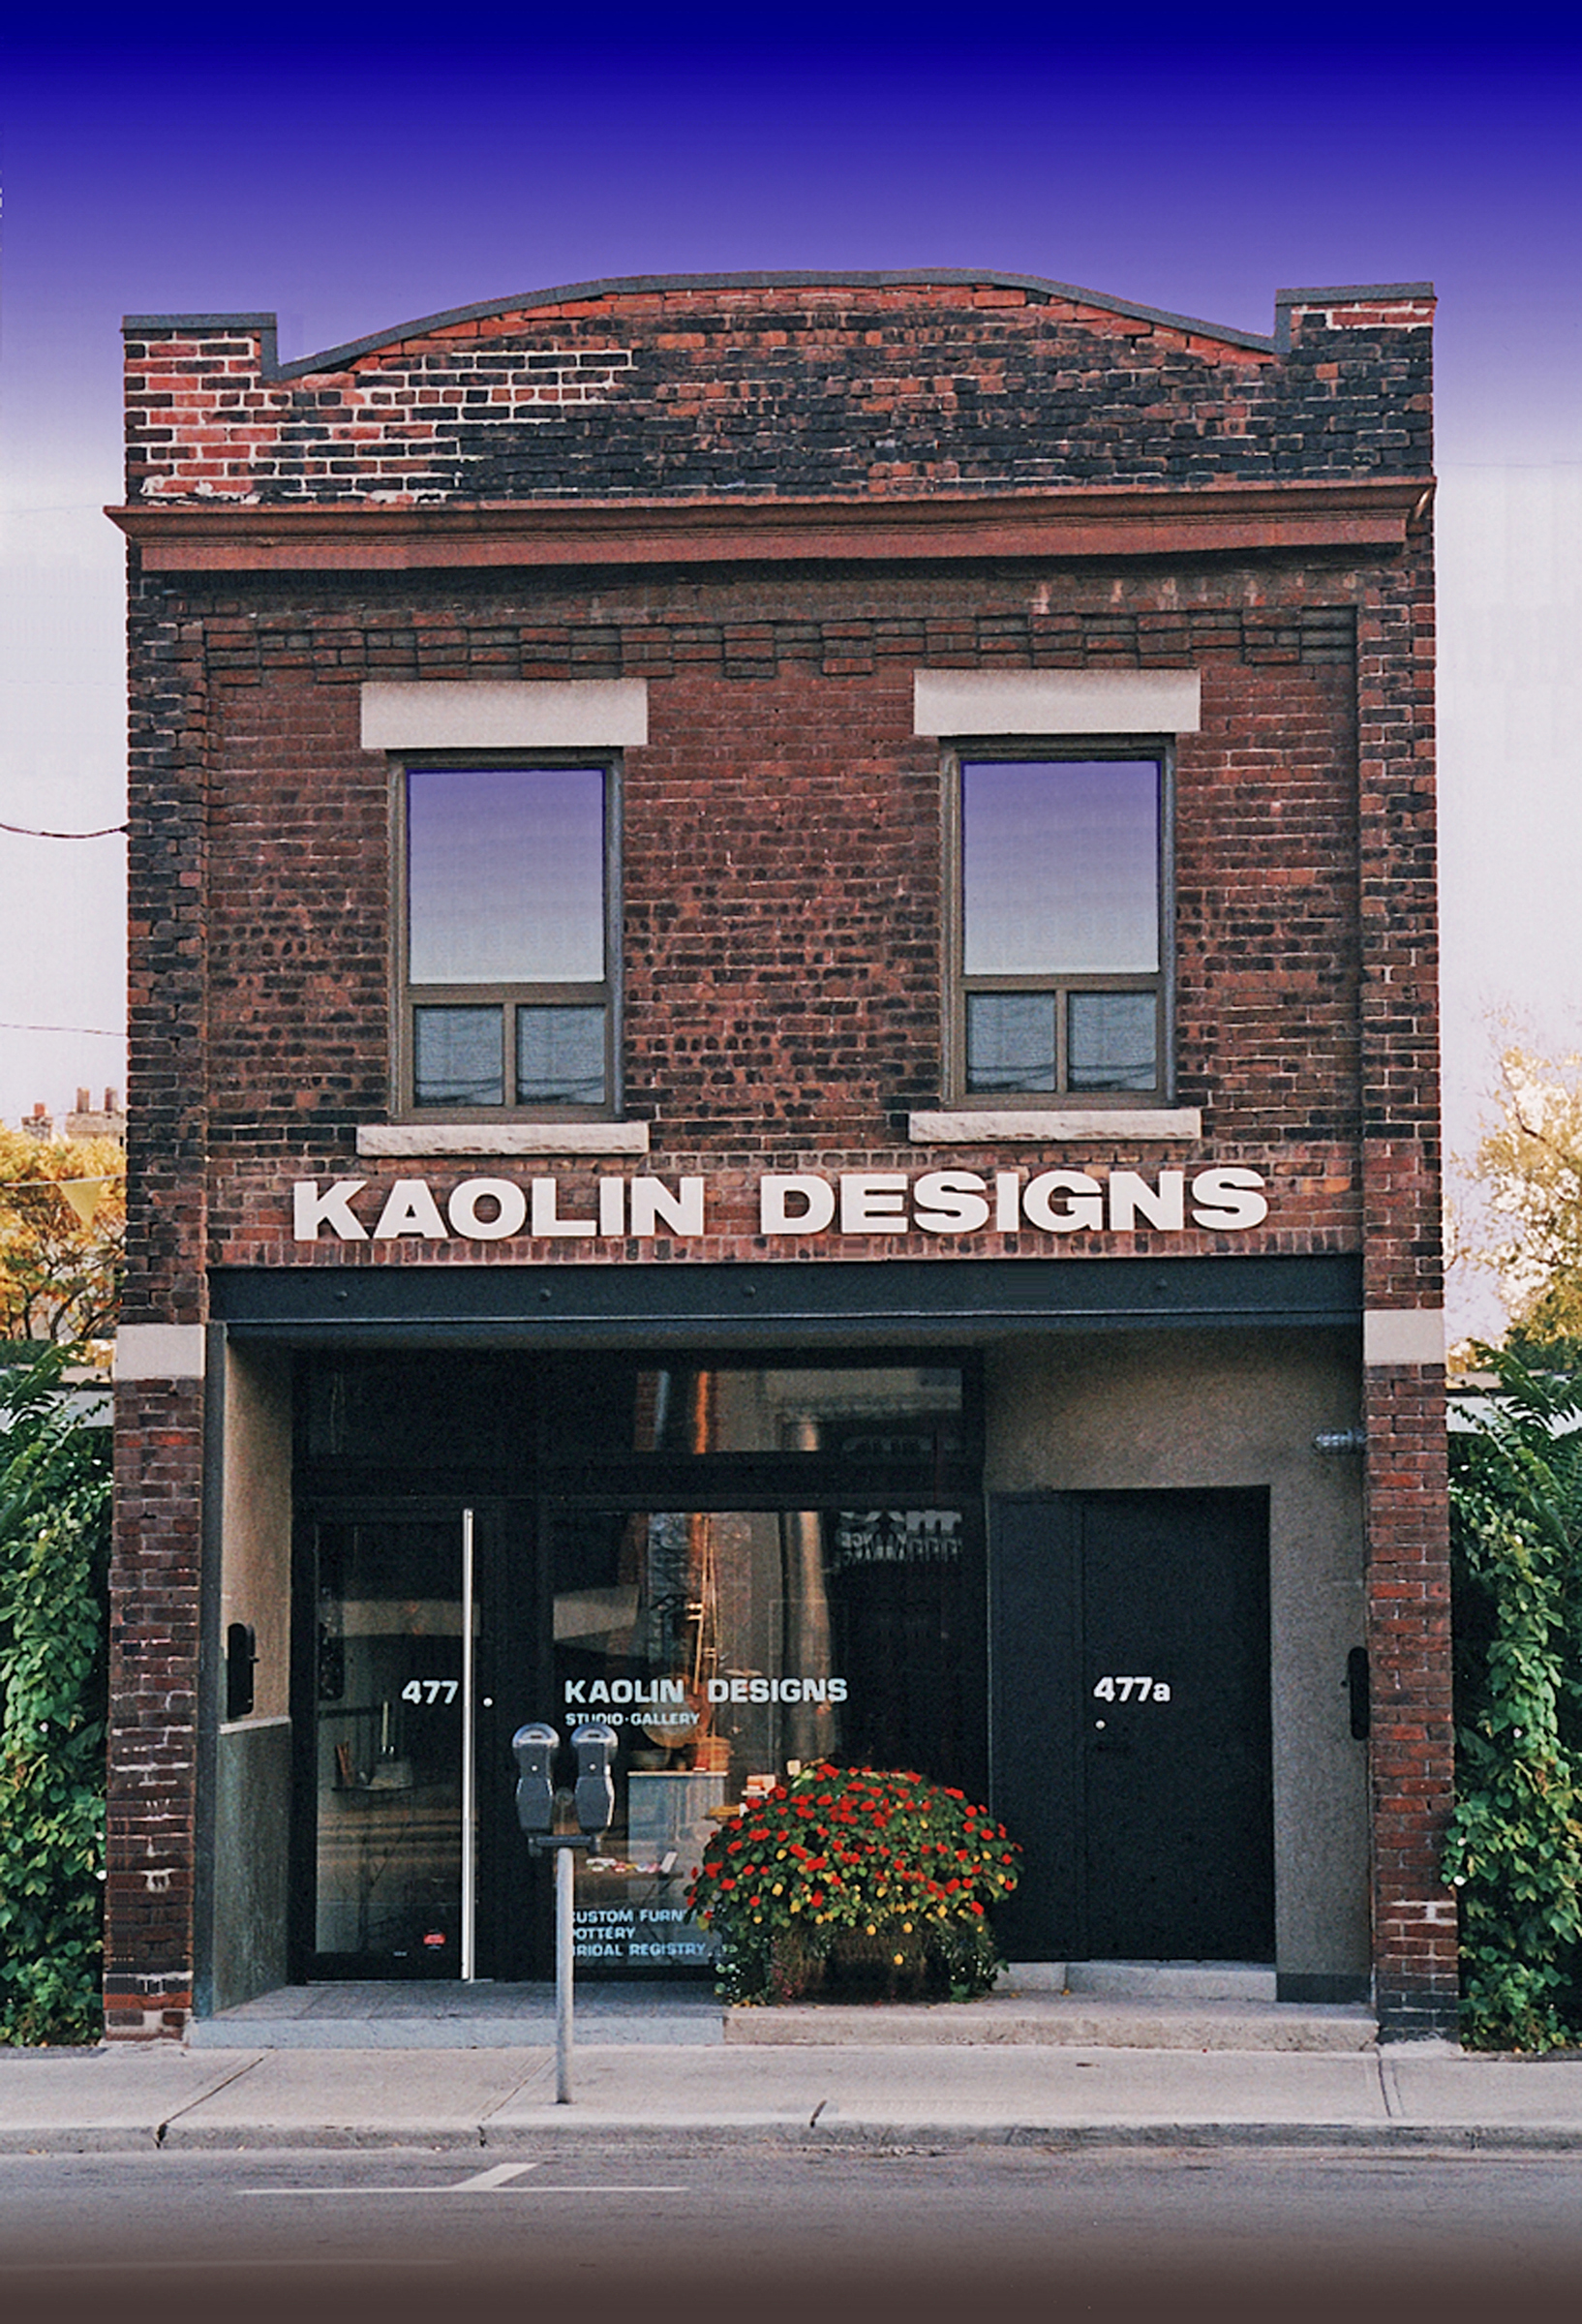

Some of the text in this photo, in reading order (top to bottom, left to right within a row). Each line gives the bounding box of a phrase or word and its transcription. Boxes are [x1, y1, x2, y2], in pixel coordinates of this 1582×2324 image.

[293, 1168, 1268, 1240] KAOLIN DESIGNS
[401, 1679, 458, 1704] 477
[564, 1677, 848, 1704] KAOLIN DESIGNS
[1093, 1676, 1171, 1702] 477a
[573, 1909, 633, 1924] USTOM
[629, 1942, 706, 1957] REGISTRY
